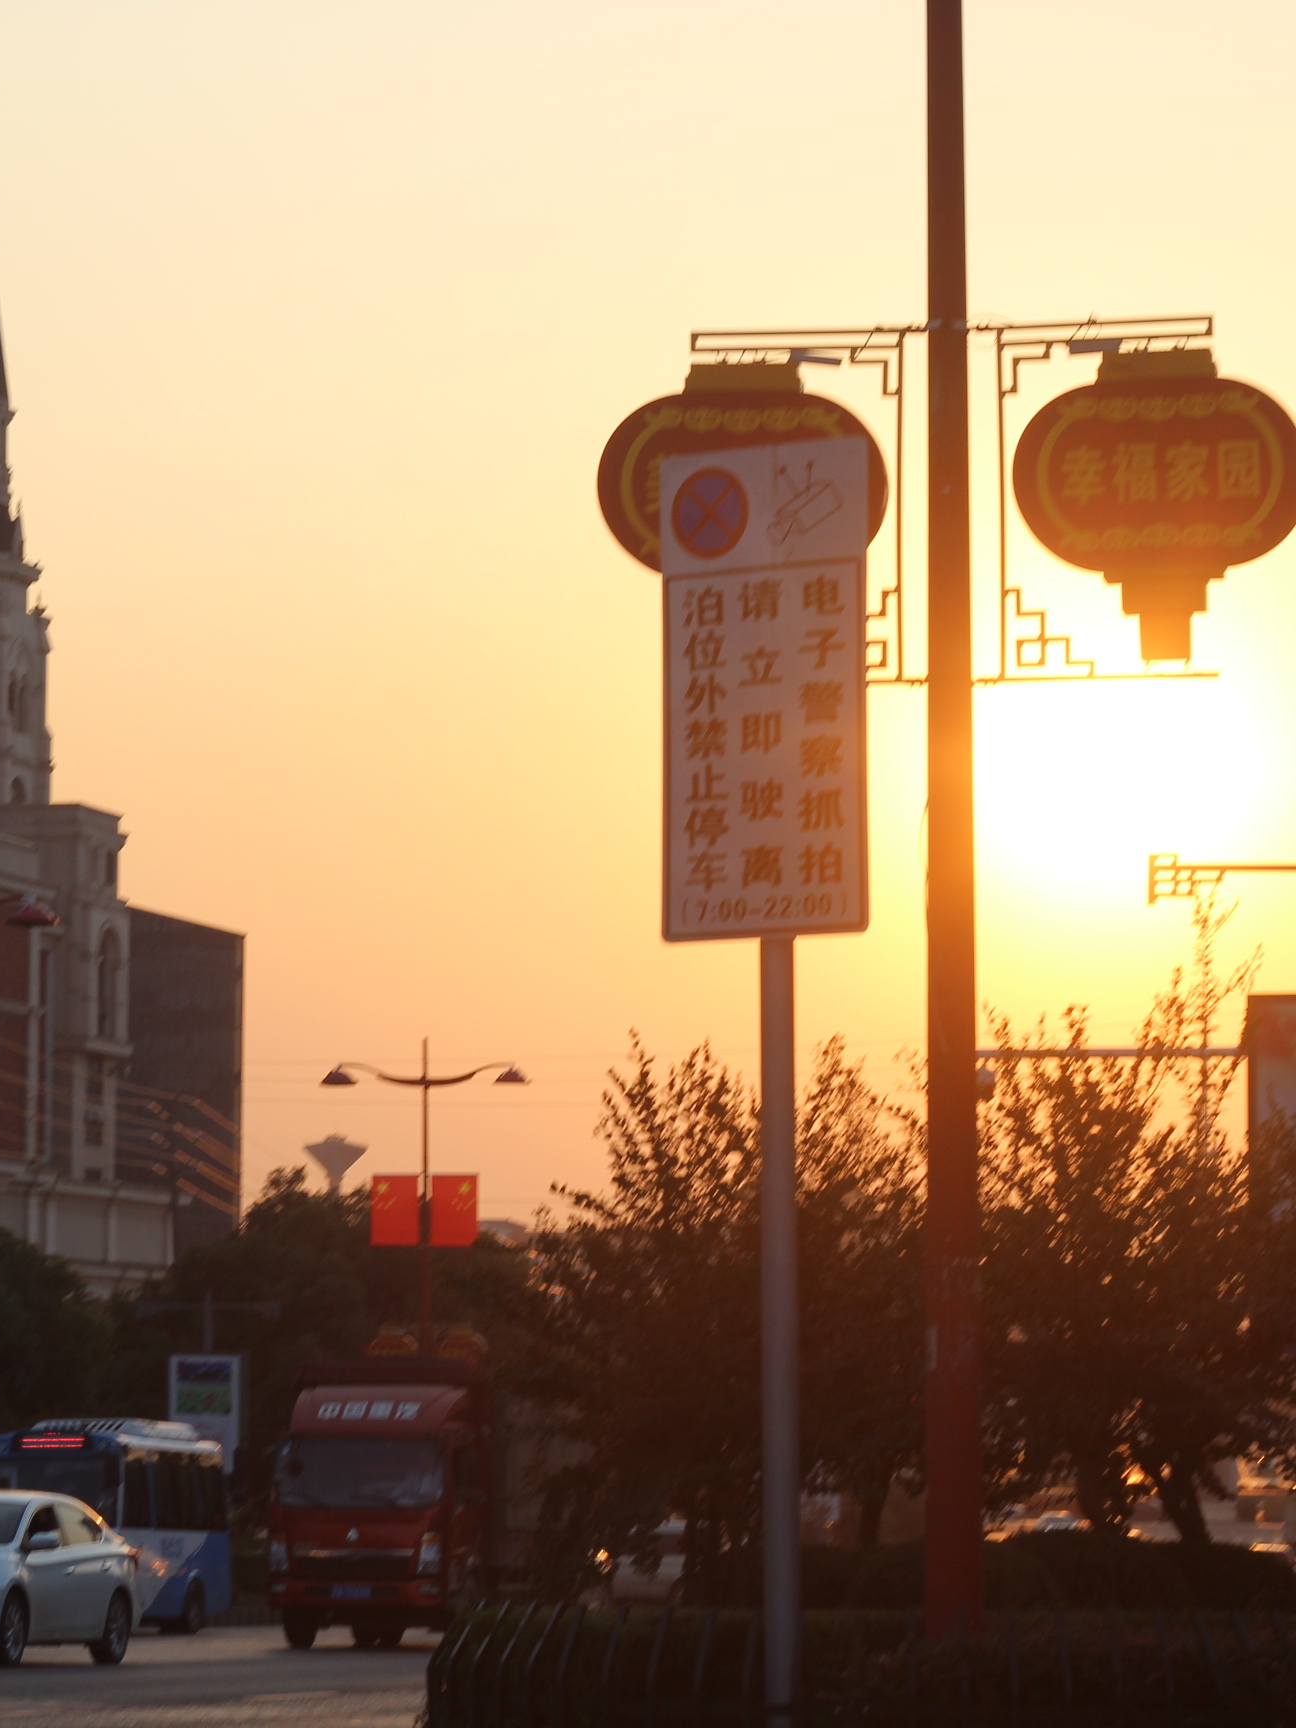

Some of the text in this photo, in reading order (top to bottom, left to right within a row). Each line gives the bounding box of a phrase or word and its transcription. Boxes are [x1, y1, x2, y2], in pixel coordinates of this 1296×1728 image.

[1060, 439, 1261, 506] 幸福家园
[682, 584, 730, 893] 泊位外禁止停车
[737, 577, 785, 888] 请立即驶离
[798, 574, 846, 886] 电子警察抓拍
[316, 1400, 422, 1421] 中国重汽
